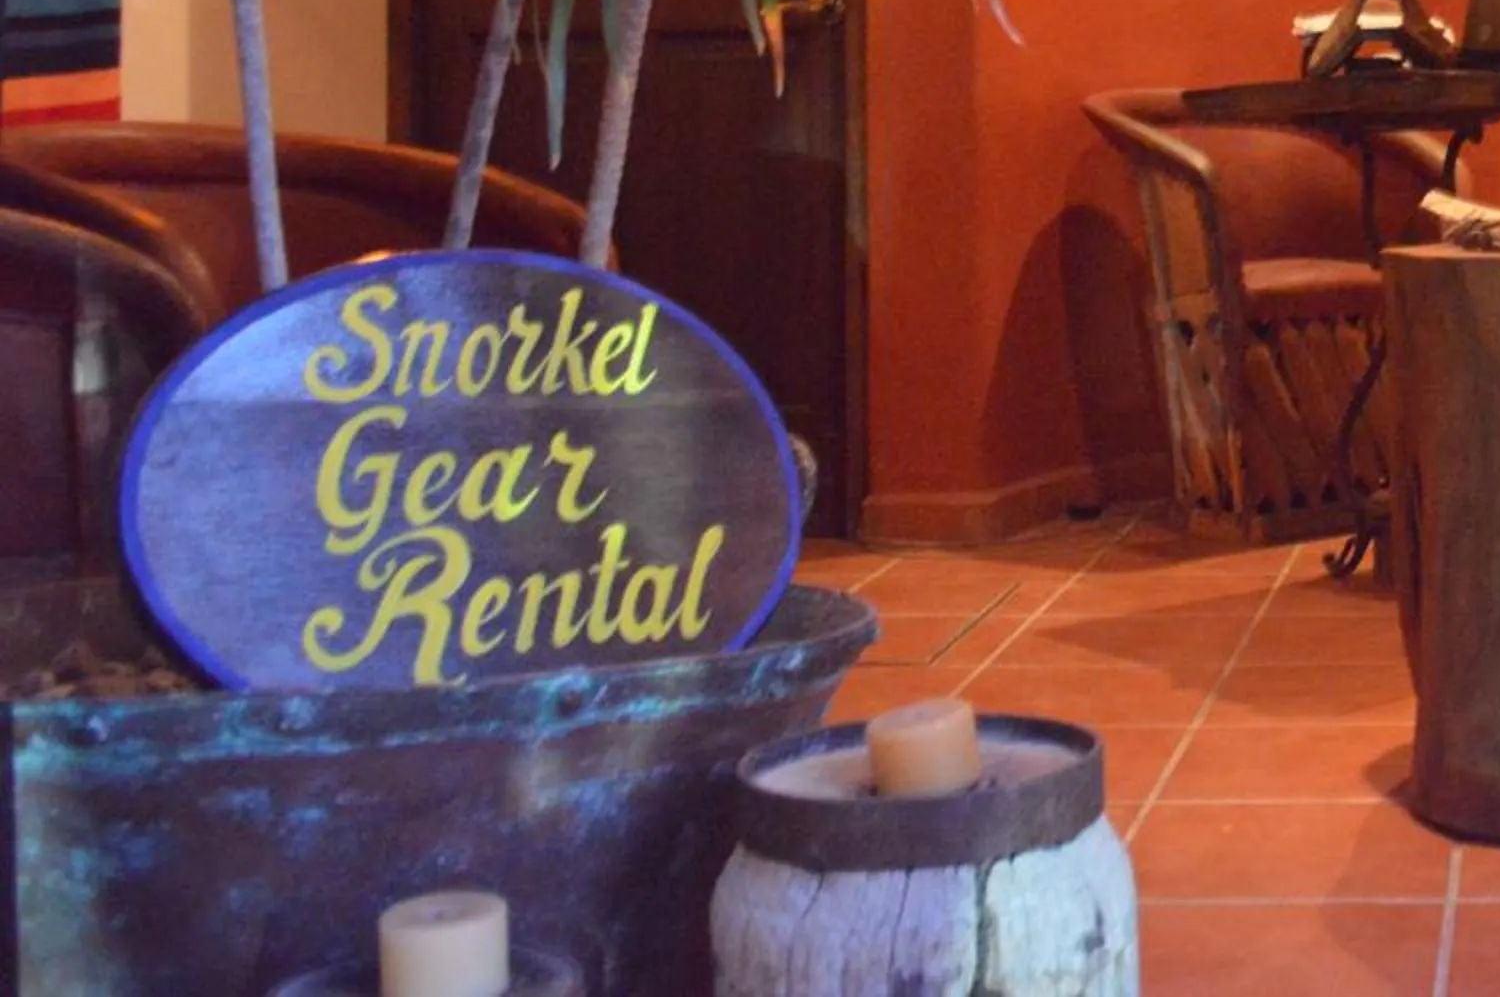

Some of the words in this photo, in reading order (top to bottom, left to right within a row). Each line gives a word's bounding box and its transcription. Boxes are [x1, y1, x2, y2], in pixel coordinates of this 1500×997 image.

[304, 285, 657, 402] Snorkel
[316, 407, 607, 554] Gear
[303, 522, 724, 687] Rental
